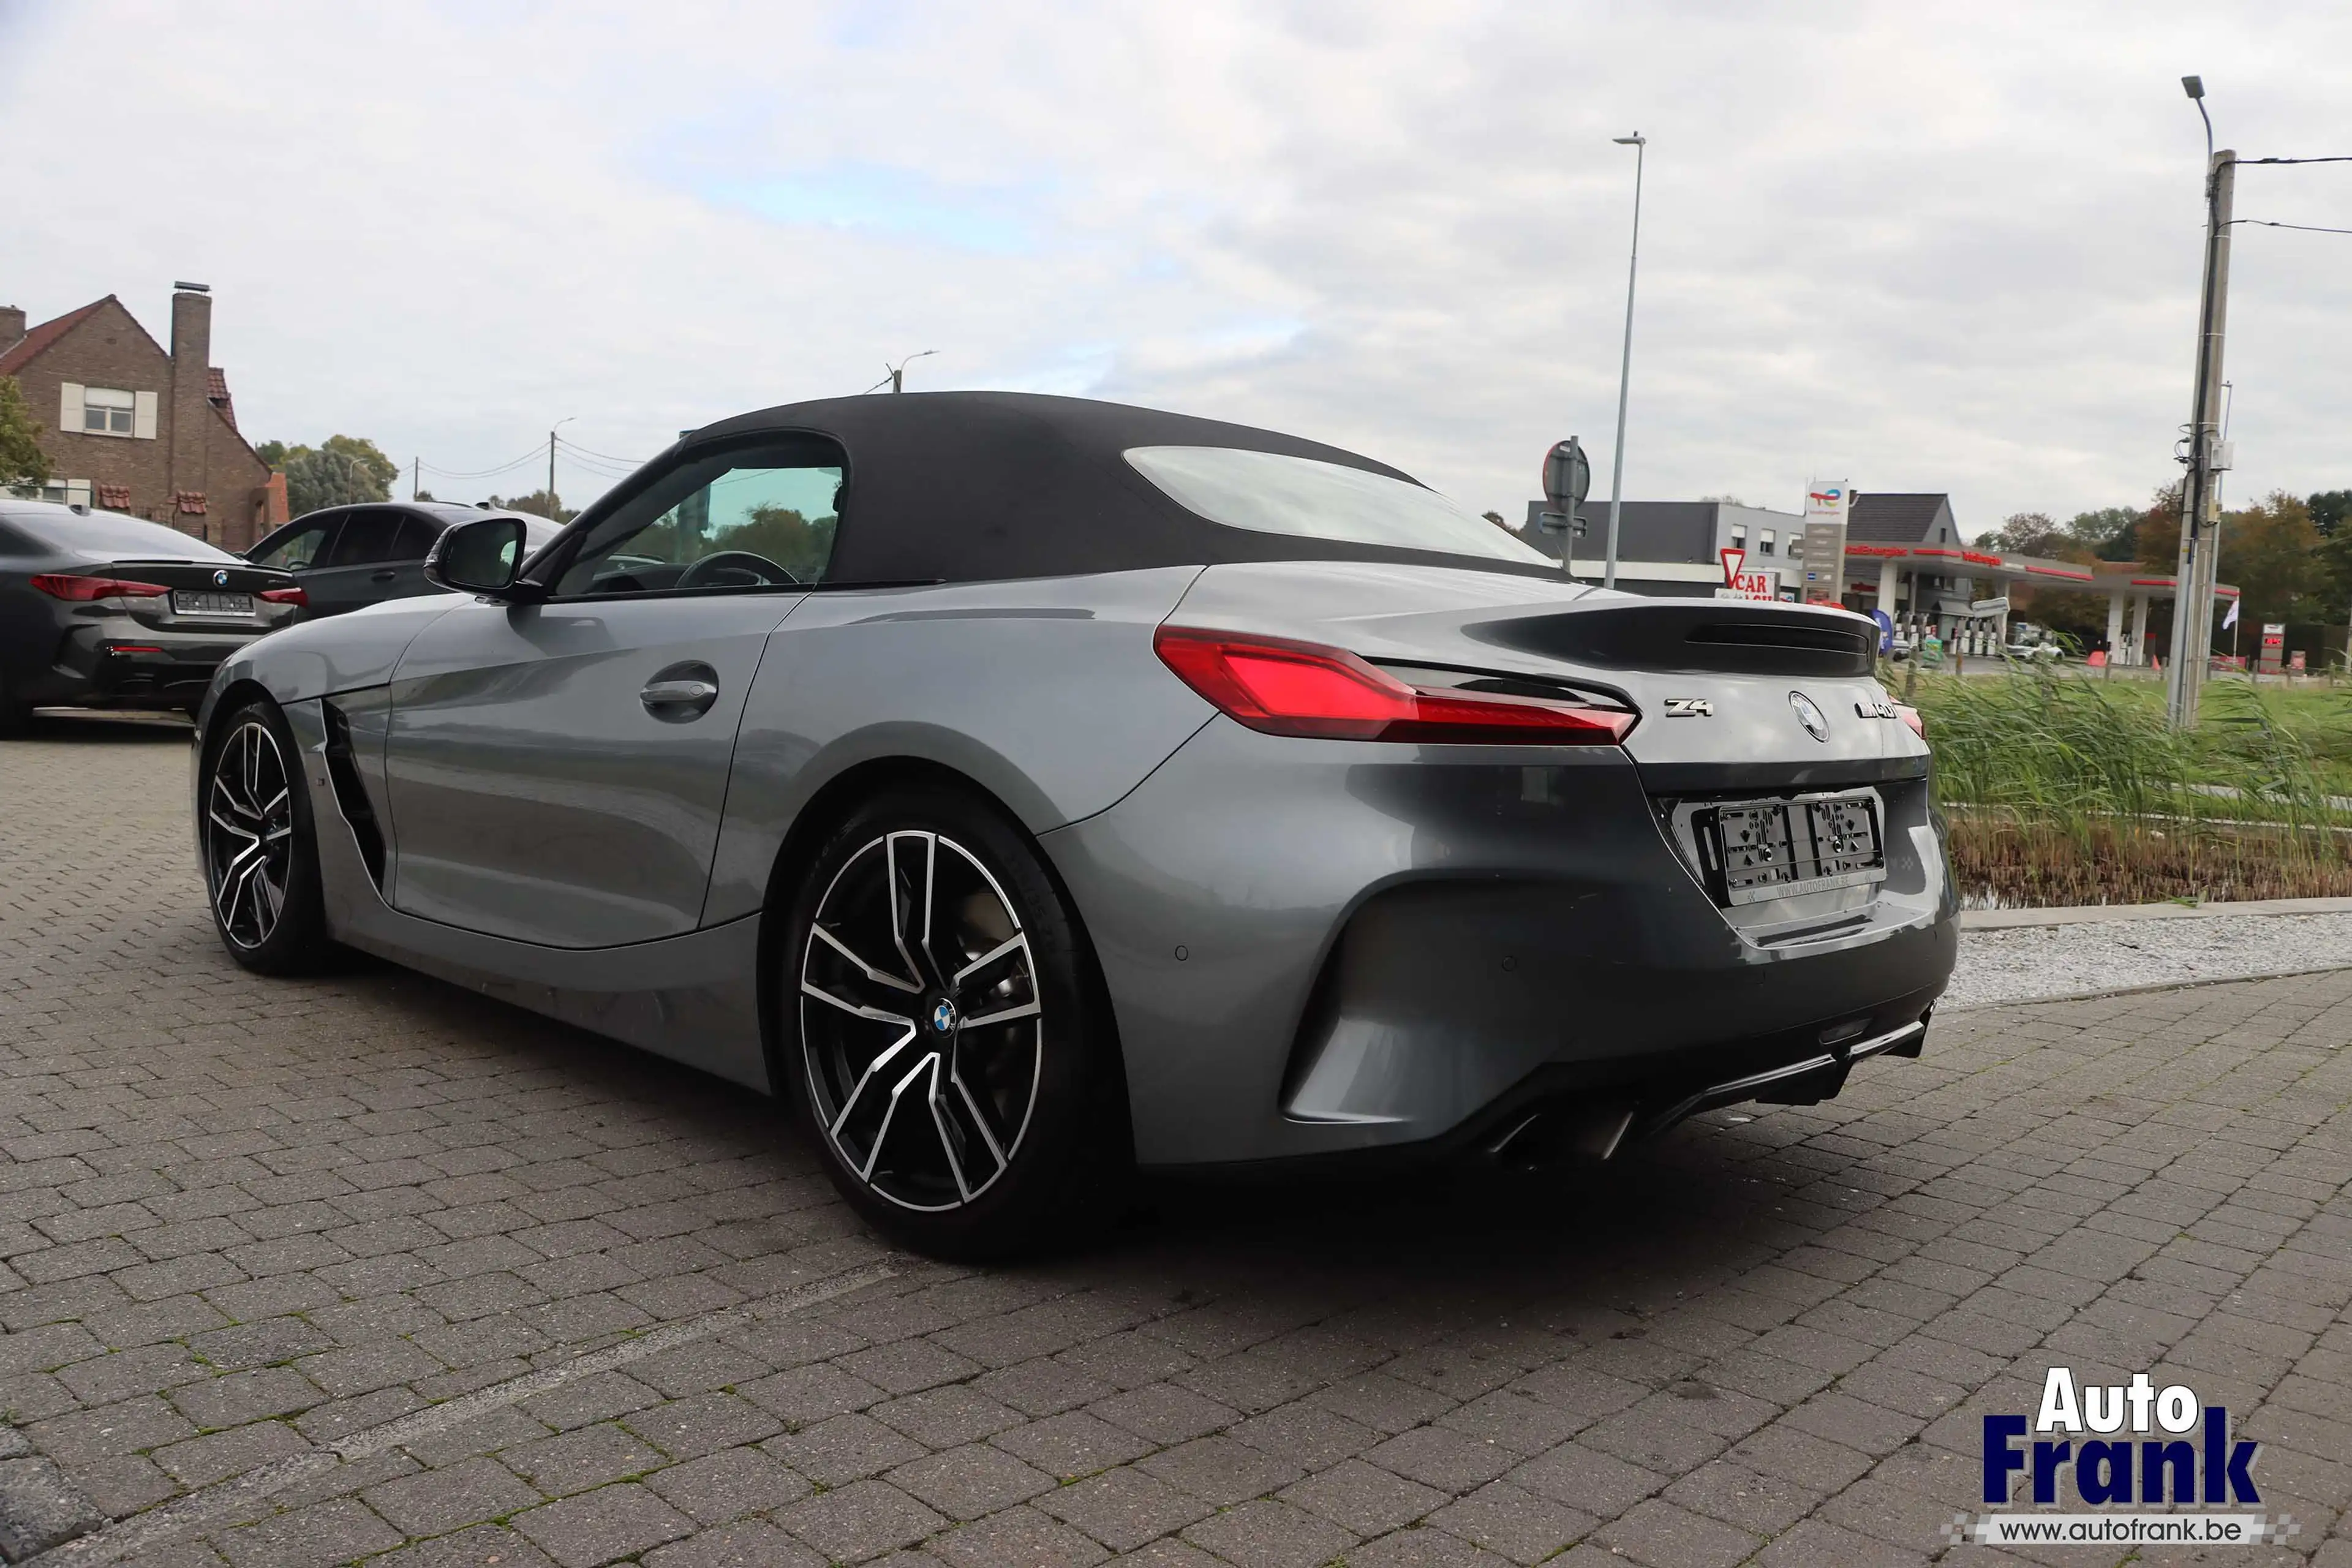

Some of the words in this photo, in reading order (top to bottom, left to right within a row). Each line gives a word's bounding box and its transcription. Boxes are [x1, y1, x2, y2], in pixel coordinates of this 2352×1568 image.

[1736, 575, 1766, 593] CAR
[1664, 698, 1713, 717] Z4
[1777, 875, 1849, 899] WWW.AUTOFRANK.BE
